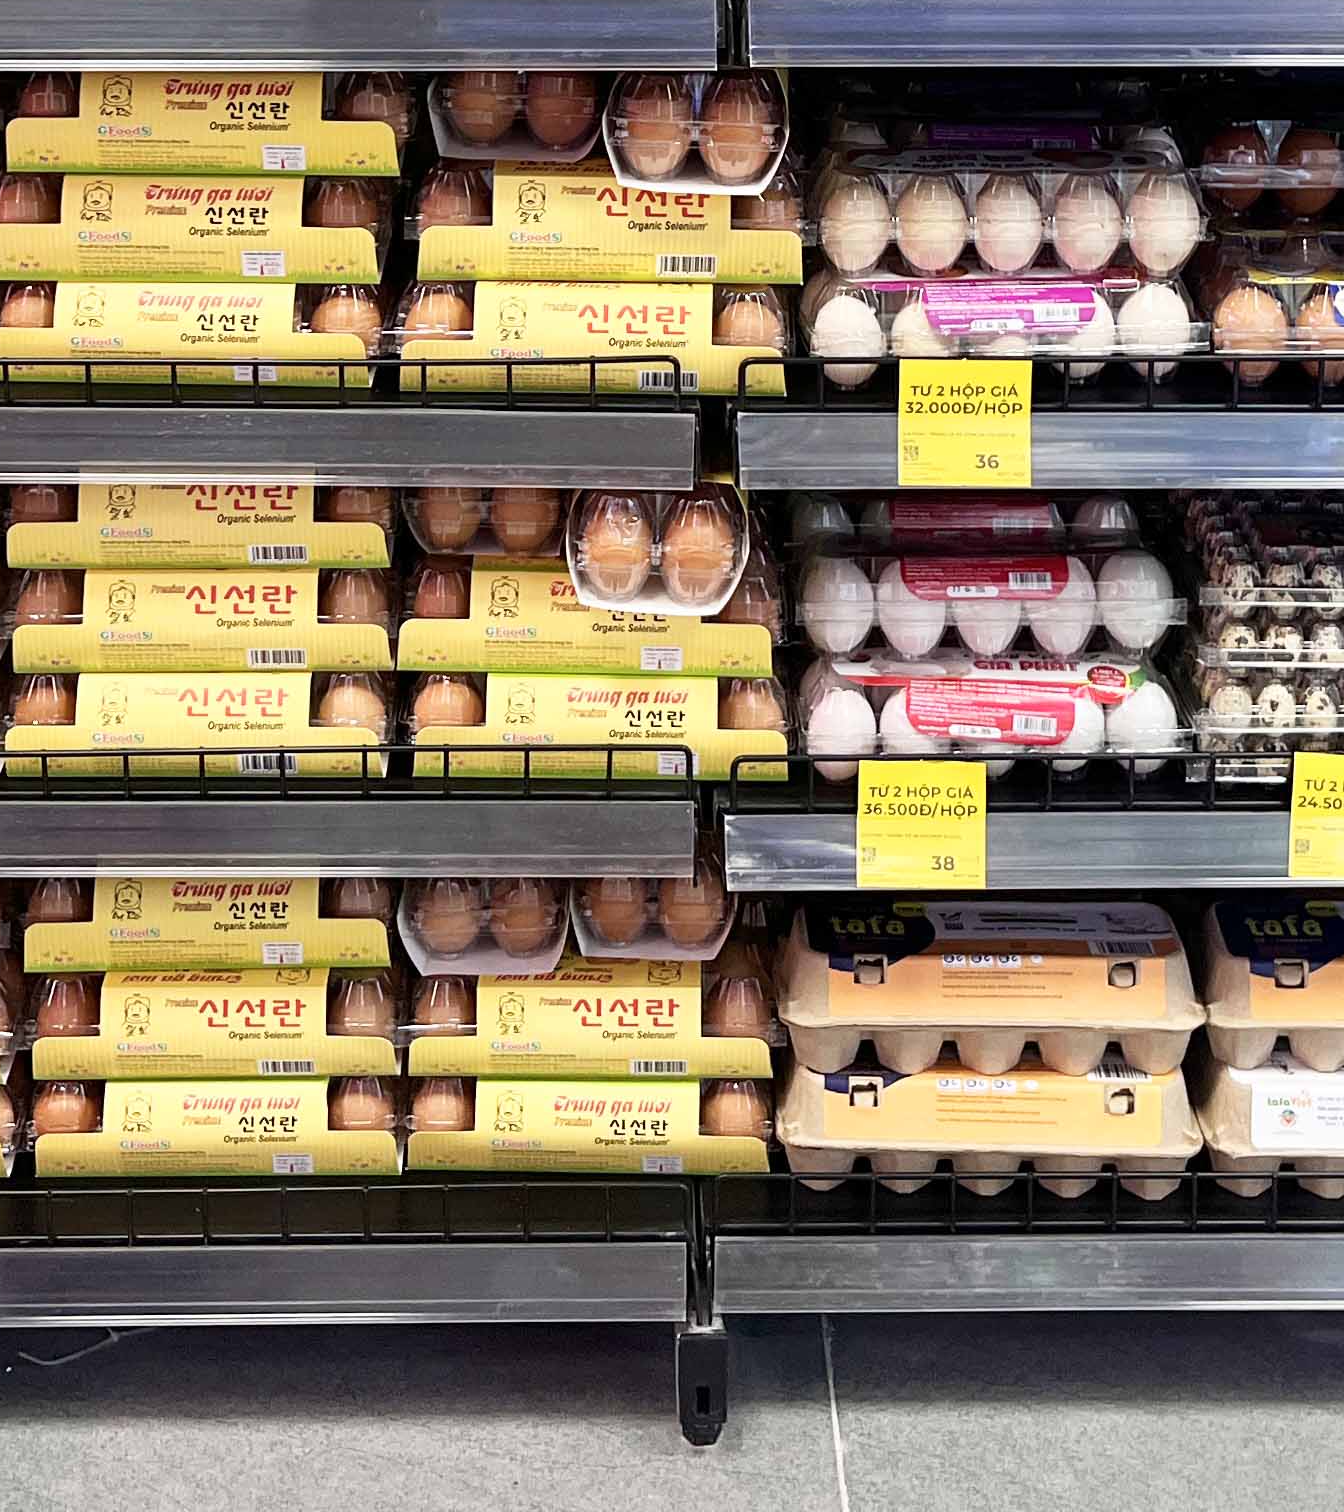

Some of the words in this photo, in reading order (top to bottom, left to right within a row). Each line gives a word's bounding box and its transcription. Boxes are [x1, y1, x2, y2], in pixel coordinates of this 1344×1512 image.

[577, 303, 693, 336] 신선란
[905, 399, 1023, 418] 32.000Đ/HỘP
[975, 454, 1000, 469] 36
[185, 582, 299, 616] 신선란
[894, 786, 902, 798] 2
[906, 784, 941, 801] HỘP
[946, 786, 974, 798] GIÁ
[864, 802, 978, 820] 36.500Đ/HỘP
[931, 856, 954, 871] 38
[830, 914, 906, 937] tafa
